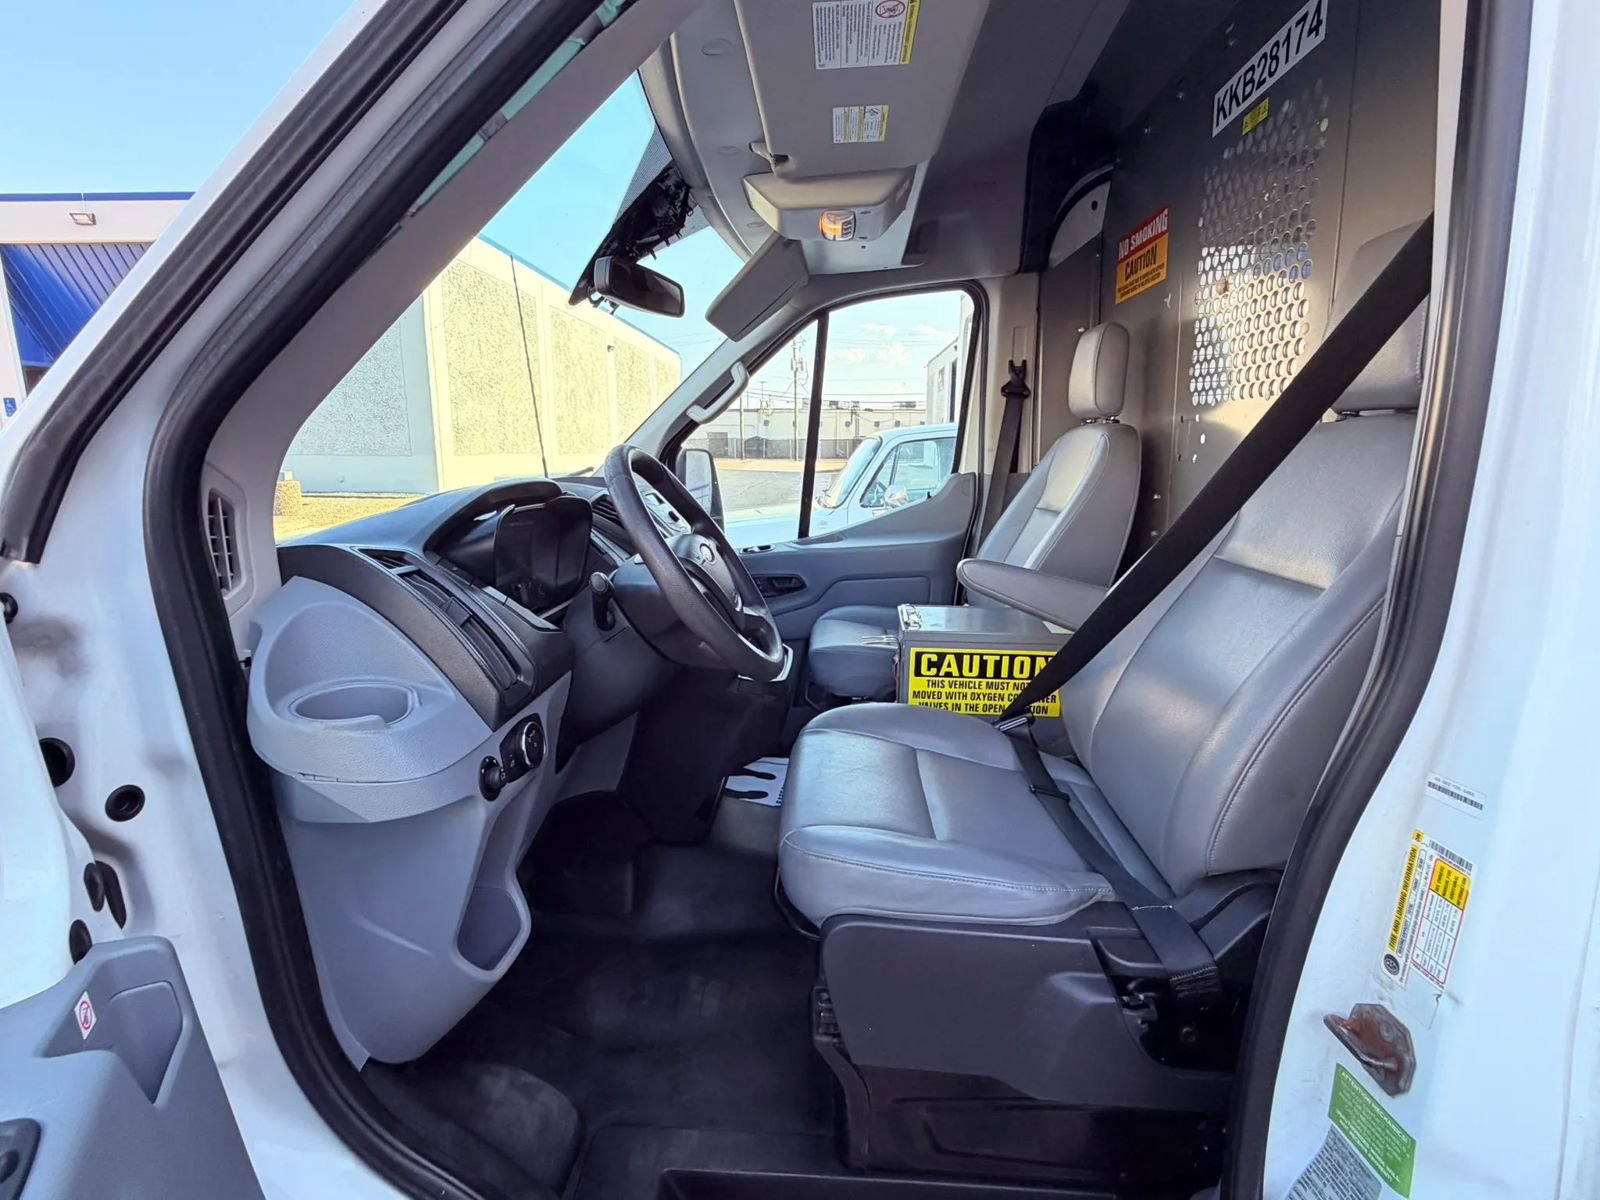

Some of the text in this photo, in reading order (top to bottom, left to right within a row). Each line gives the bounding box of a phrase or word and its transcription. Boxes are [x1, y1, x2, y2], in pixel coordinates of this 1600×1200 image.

[1216, 0, 1323, 127] KKB28174
[1118, 208, 1168, 260] NO SMOKING
[1125, 243, 1157, 280] CAUTION
[912, 690, 943, 700] MOVED
[945, 691, 968, 701] WITH
[970, 692, 1005, 702] OXYGEN
[926, 679, 1029, 691] THIS VEHICLE MUST NO
[951, 703, 962, 712] IN
[964, 703, 980, 712] THE
[982, 704, 1005, 713] OPEN
[1389, 846, 1418, 949] TIRE AND LOADING INFORMATION
